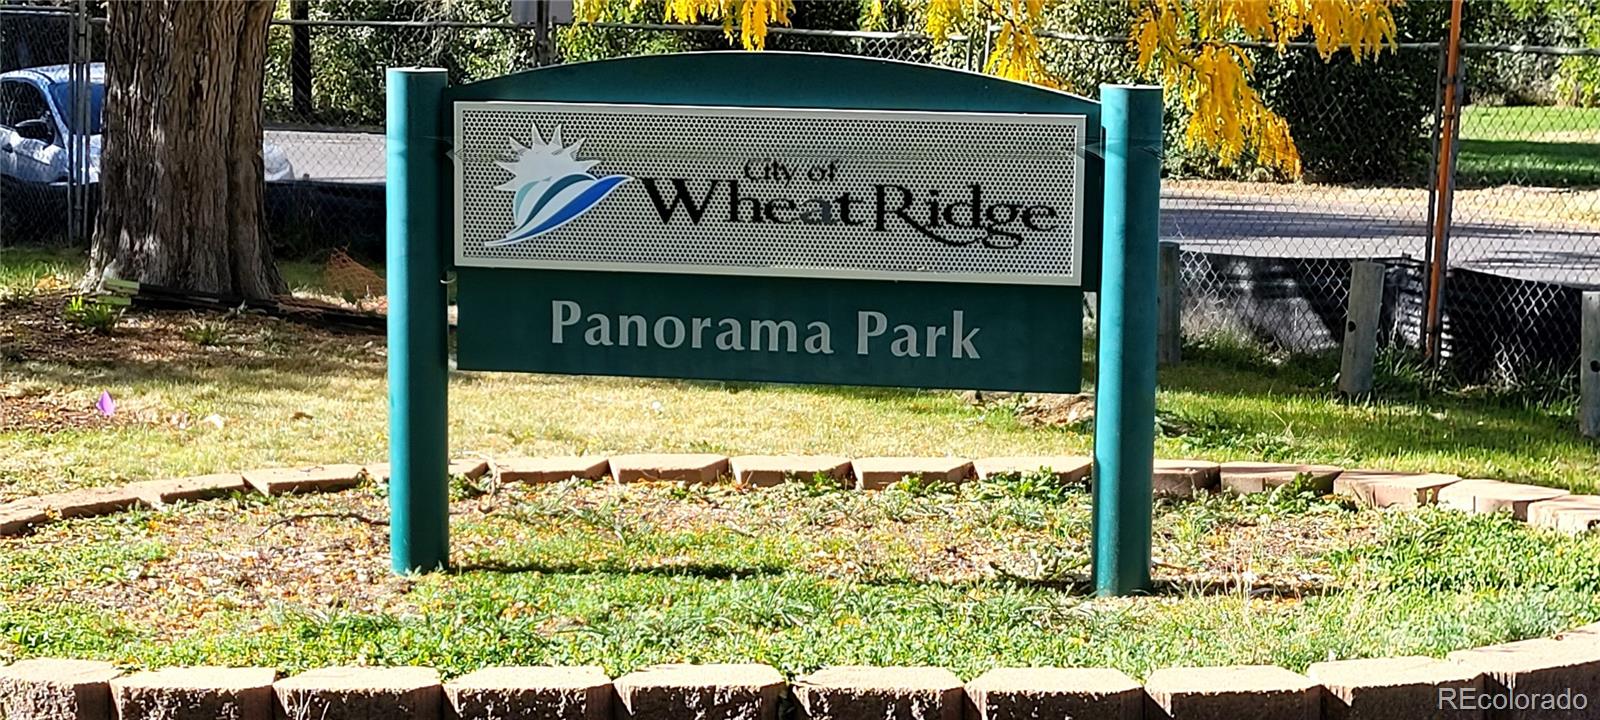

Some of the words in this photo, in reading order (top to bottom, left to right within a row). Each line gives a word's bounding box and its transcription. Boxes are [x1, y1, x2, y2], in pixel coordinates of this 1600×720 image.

[743, 159, 795, 185] City
[807, 159, 839, 183] of
[874, 183, 1059, 250] Ridge
[551, 299, 834, 355] Panorama
[856, 310, 981, 360] Park
